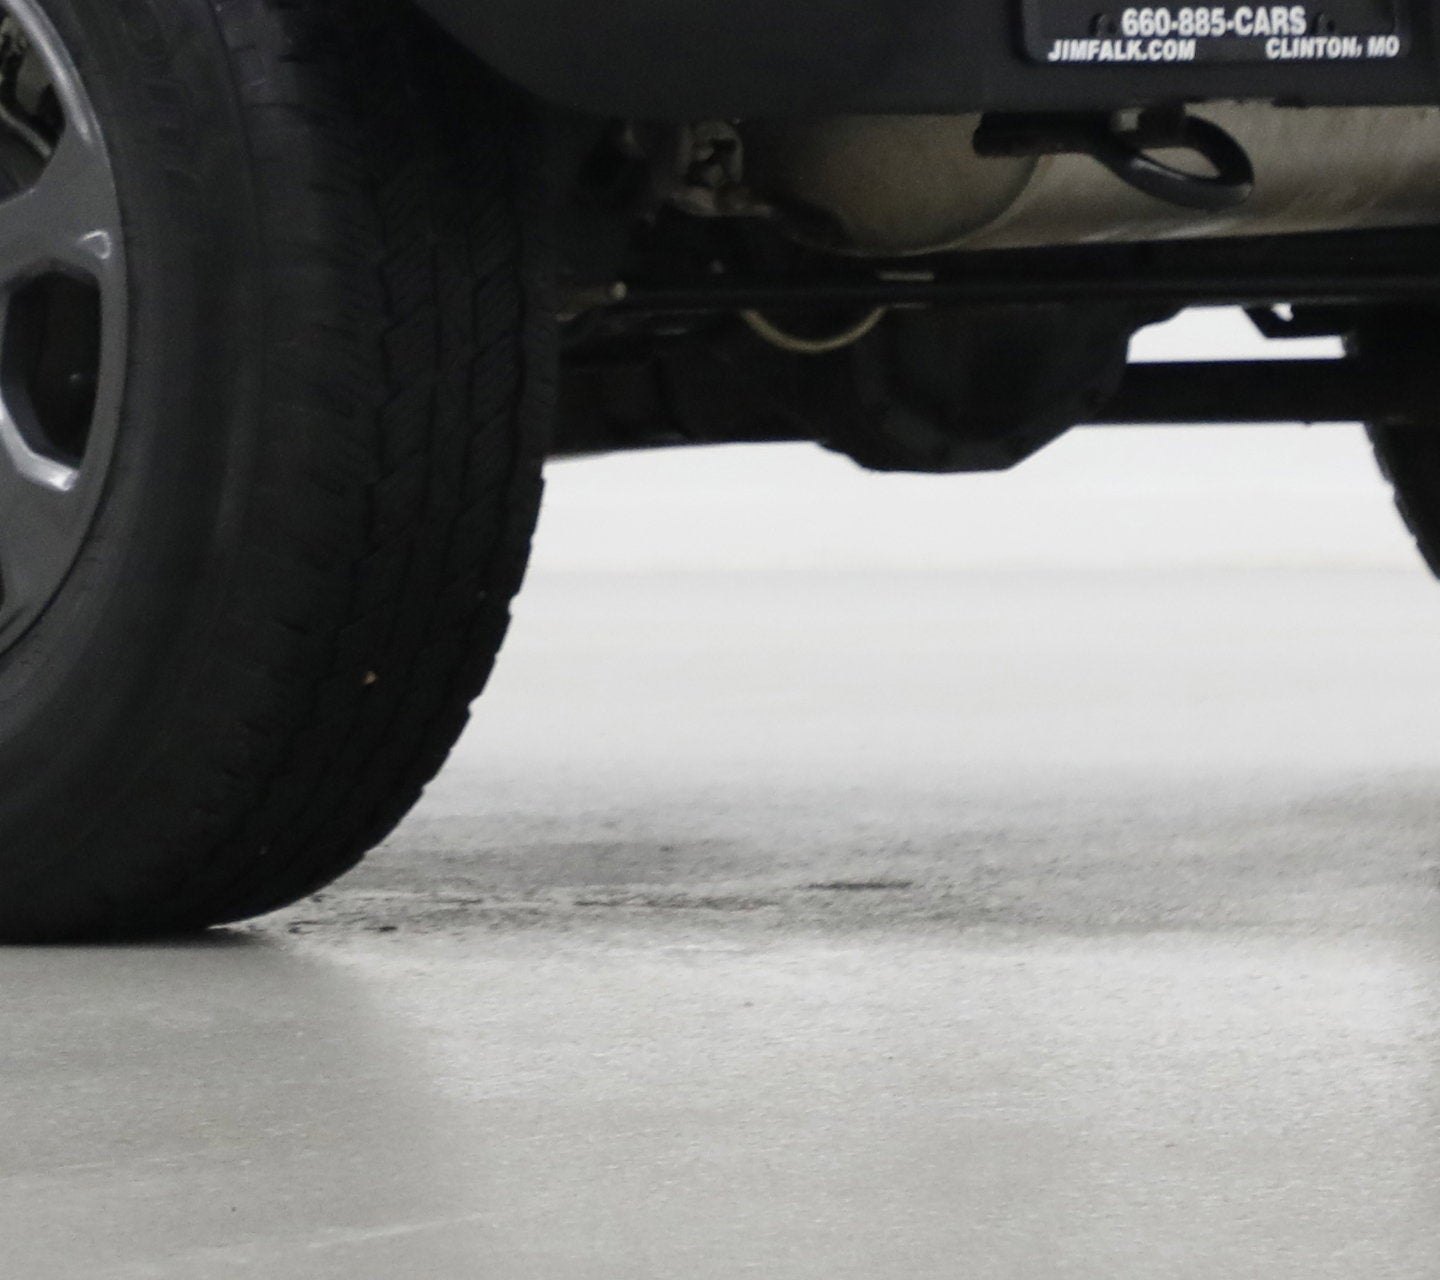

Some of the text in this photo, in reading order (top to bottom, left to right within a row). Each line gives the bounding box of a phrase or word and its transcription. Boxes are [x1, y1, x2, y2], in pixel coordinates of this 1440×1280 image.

[1121, 5, 1308, 37] 660-885-CARS
[1047, 38, 1196, 62] JIMFALK.COM
[1264, 34, 1400, 59] CLINTON, MO
